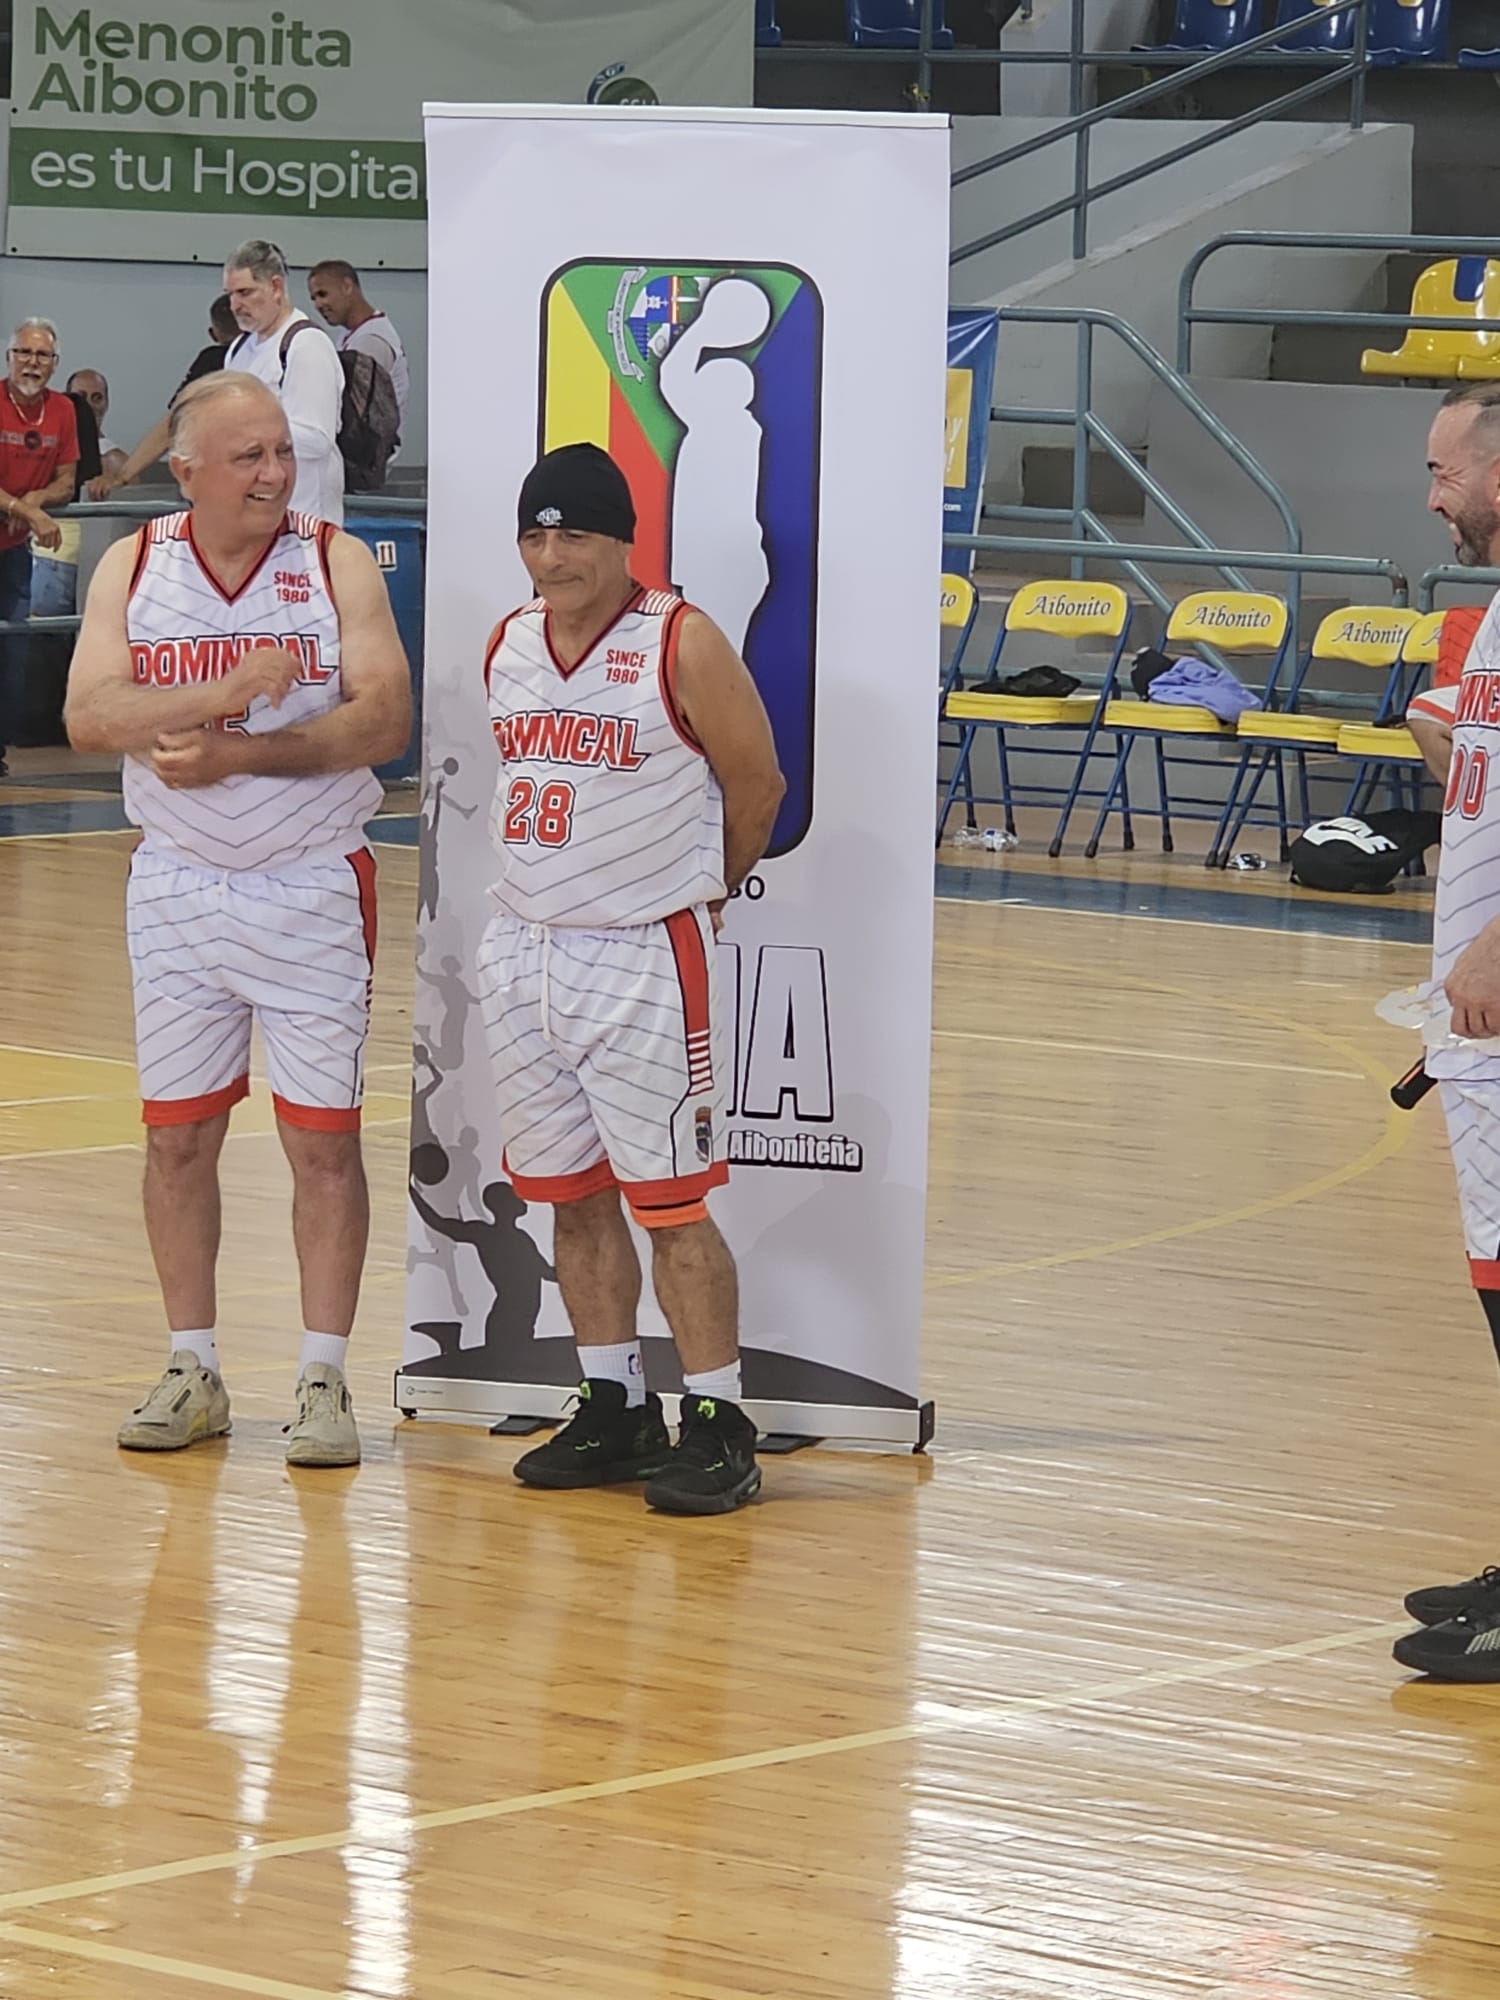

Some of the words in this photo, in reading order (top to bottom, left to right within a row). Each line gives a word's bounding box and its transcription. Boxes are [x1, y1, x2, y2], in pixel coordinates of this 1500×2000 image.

[35, 7, 352, 67] Menonita
[28, 59, 318, 122] Aibonito
[30, 150, 96, 188] es
[110, 147, 172, 192] tu
[194, 147, 419, 209] Hospita
[276, 587, 310, 604] 1980
[1025, 594, 1111, 617] Aibonito
[1185, 605, 1272, 628] Aibonito
[1331, 620, 1404, 644] Aibonit
[129, 633, 339, 688] DOMINAL
[606, 648, 647, 668] SINCE
[605, 666, 640, 685] 1980
[503, 776, 576, 849] 28
[728, 1129, 862, 1173] Aiboniteña
